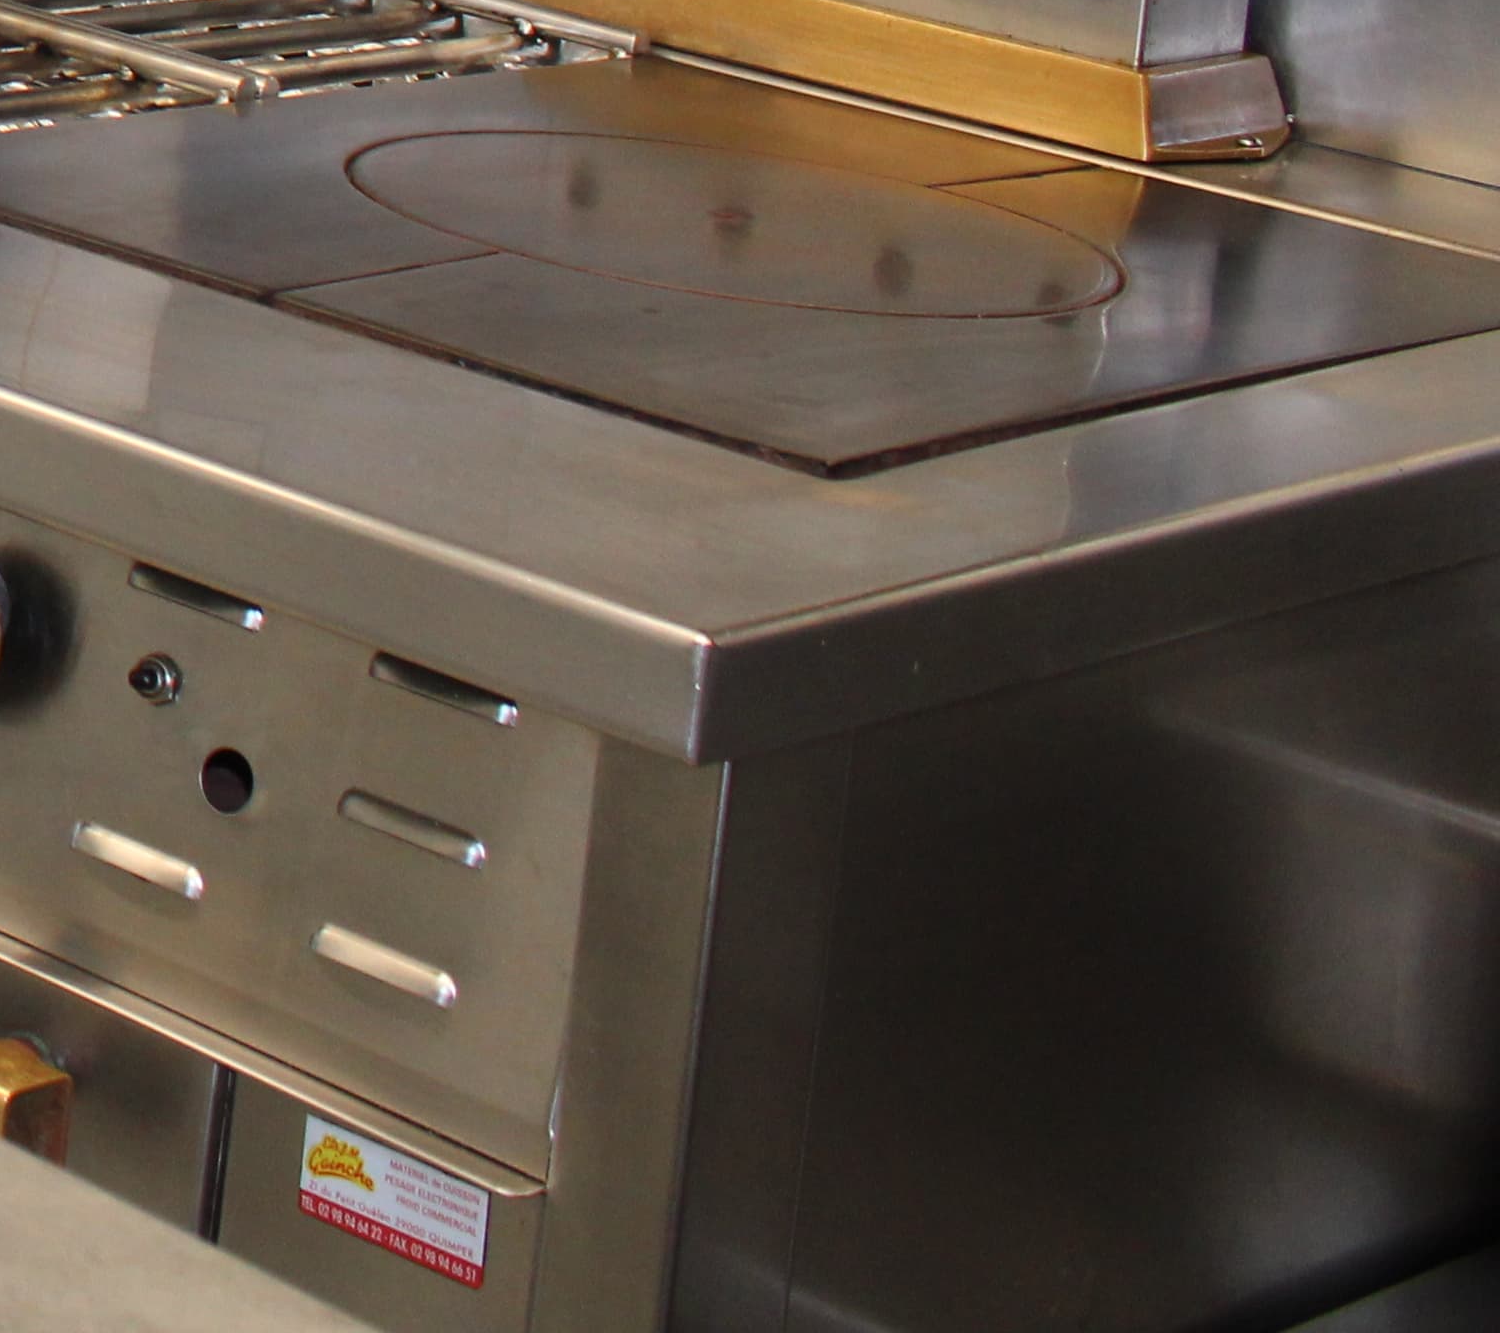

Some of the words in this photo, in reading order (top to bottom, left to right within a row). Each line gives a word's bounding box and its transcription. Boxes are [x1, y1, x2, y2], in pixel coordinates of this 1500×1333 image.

[418, 1184, 478, 1221] ELECTRONIQUE
[444, 1181, 481, 1205] CUISSON
[422, 1203, 476, 1237] COMMERCIAL
[318, 1203, 330, 1218] 02
[331, 1208, 343, 1224] 98
[344, 1214, 356, 1230] 94
[357, 1220, 369, 1235] 64
[371, 1224, 383, 1242] 22
[410, 1243, 423, 1259] 02
[425, 1249, 437, 1264] 98
[438, 1255, 450, 1270] 94
[452, 1261, 464, 1276] 66
[465, 1267, 476, 1282] 51
[429, 1230, 474, 1258] QUIMPER
